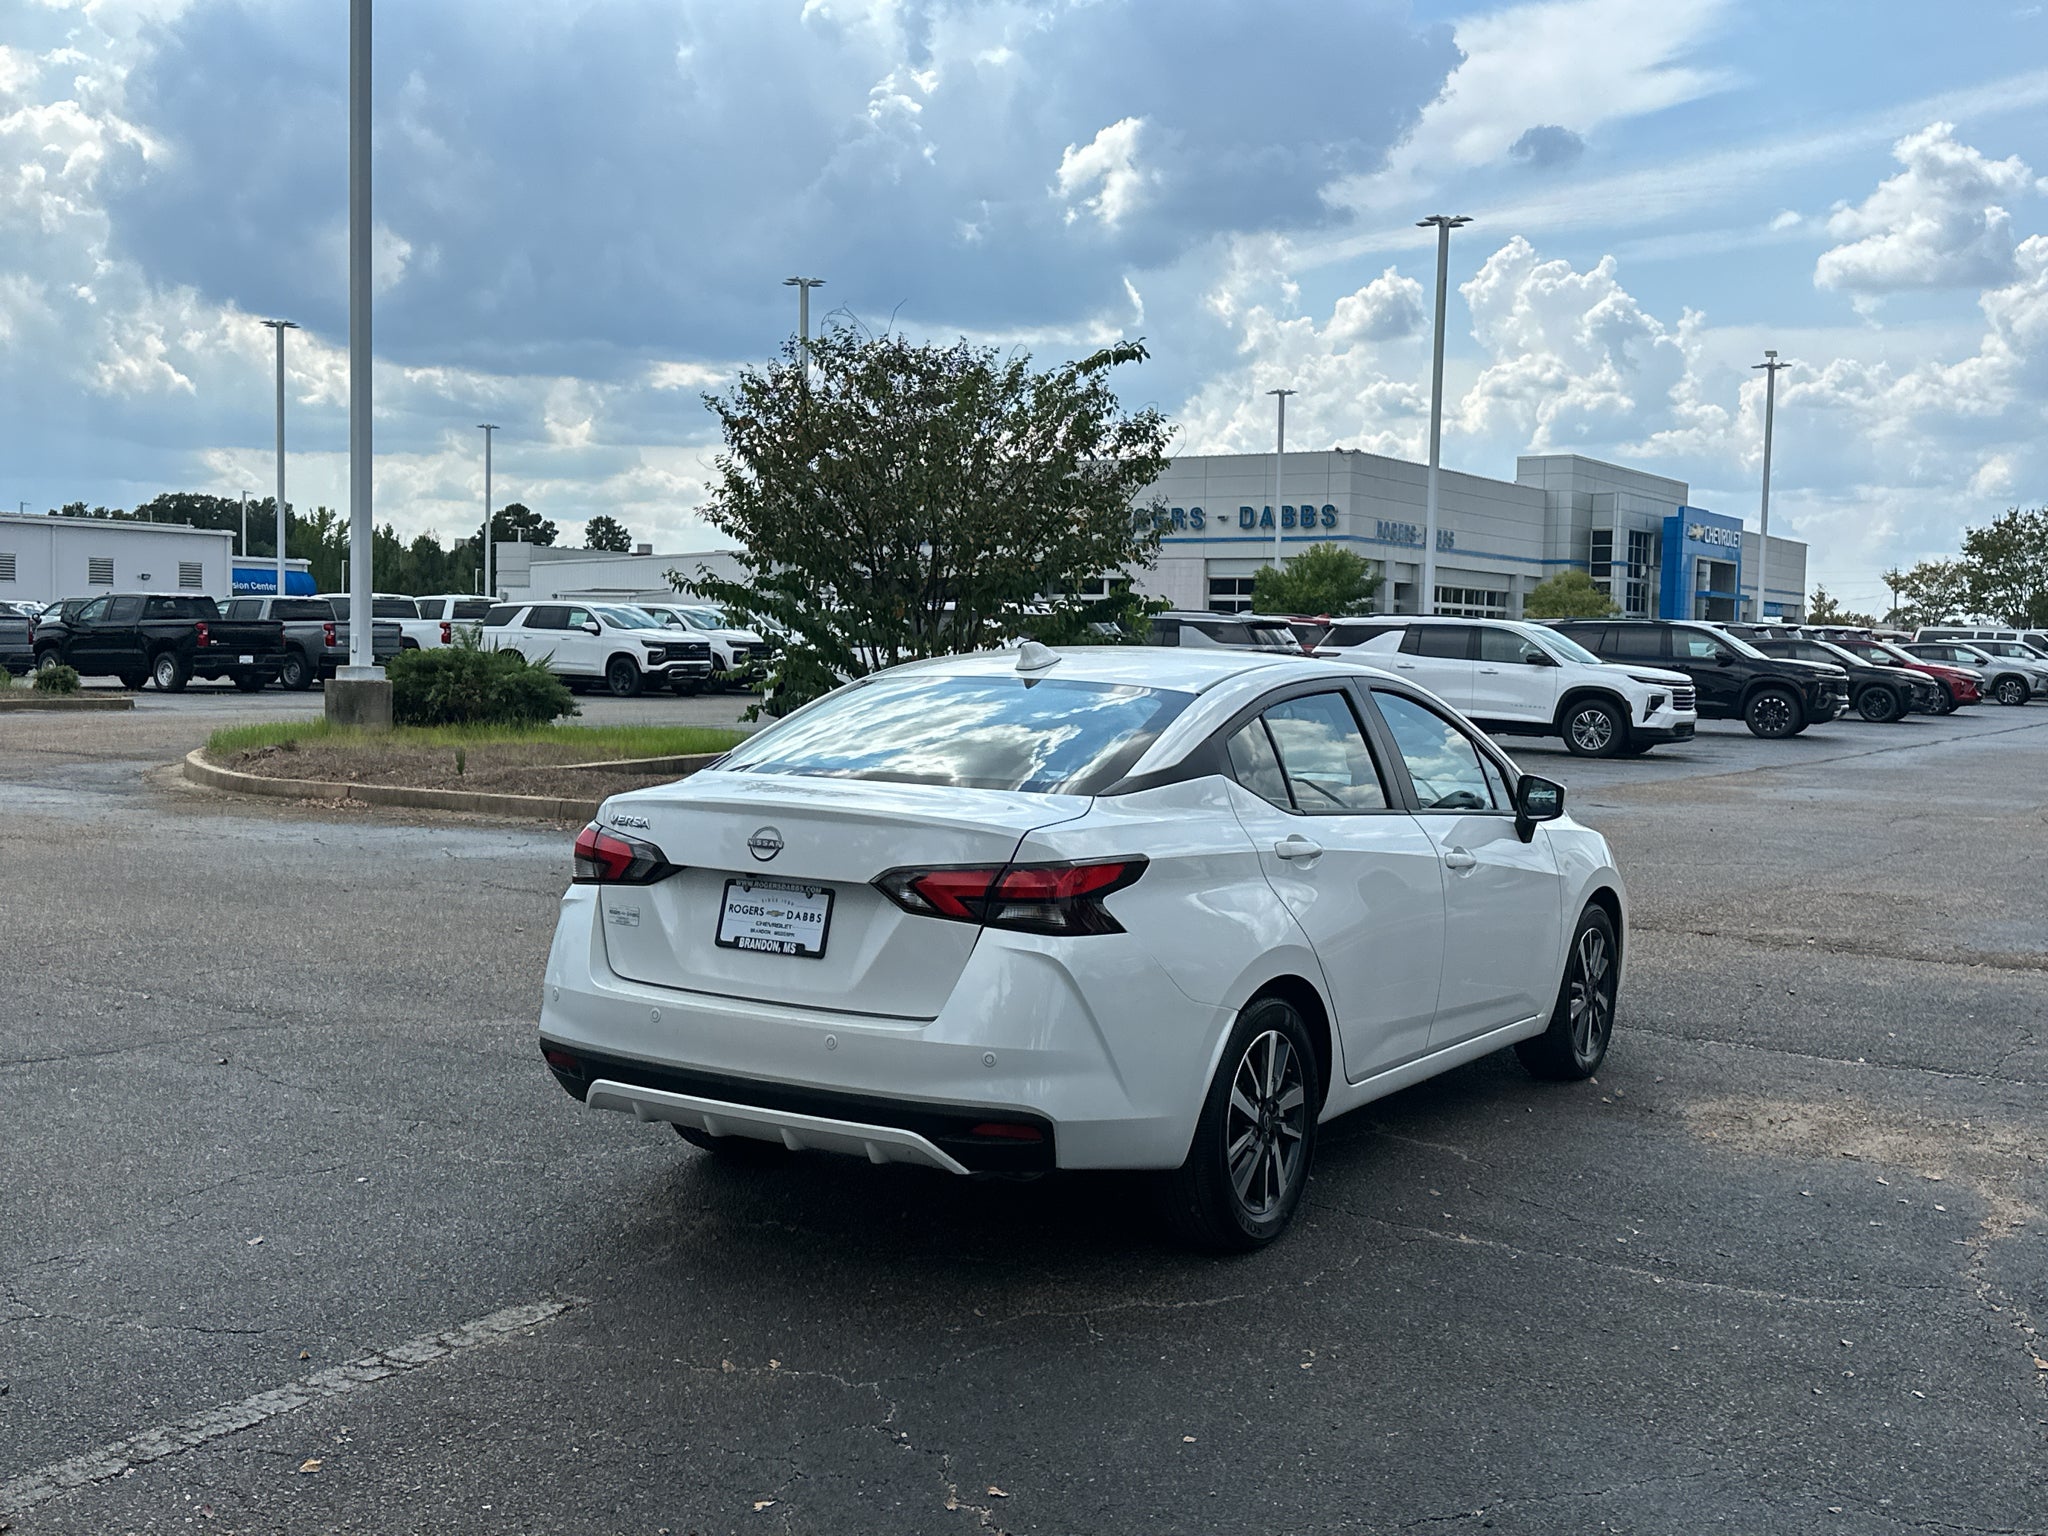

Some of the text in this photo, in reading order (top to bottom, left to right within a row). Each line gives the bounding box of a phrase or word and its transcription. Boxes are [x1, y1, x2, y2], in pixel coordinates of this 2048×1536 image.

[1239, 504, 1338, 529] DABBS
[1704, 525, 1741, 548] CHEVROLET
[250, 581, 277, 591] Center
[610, 814, 650, 830] VERSA
[747, 838, 784, 849] NISSAN
[728, 904, 822, 923] ROGERS DABBS
[755, 920, 793, 930] CHEVROLET
[738, 937, 797, 954] BRANDON, MS
